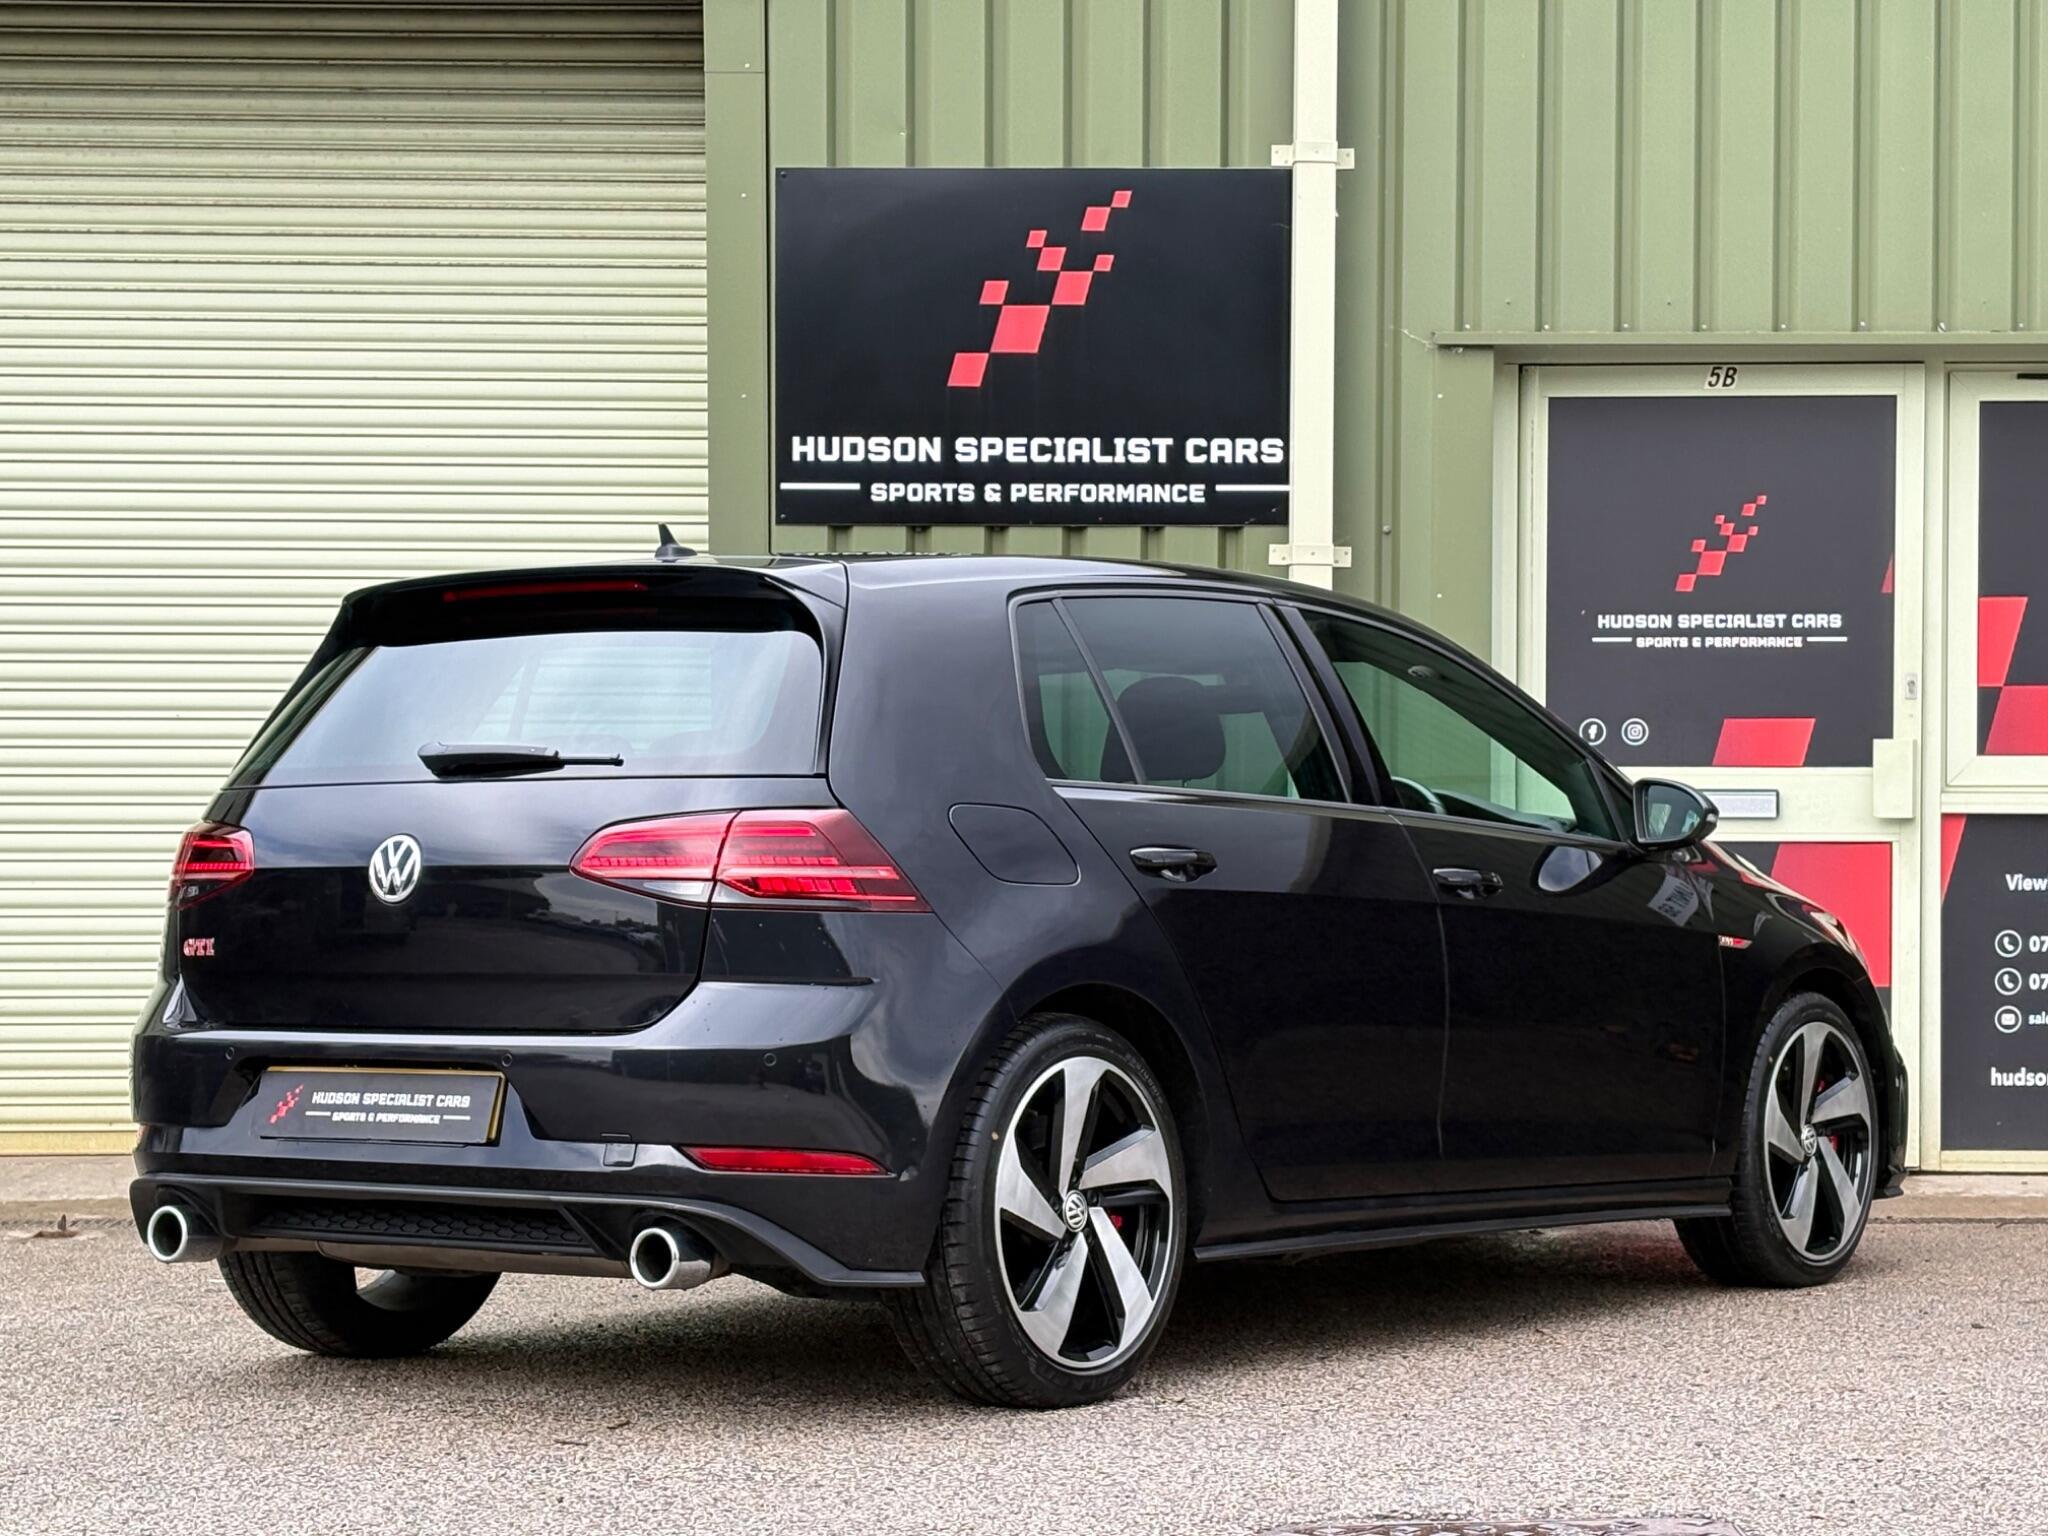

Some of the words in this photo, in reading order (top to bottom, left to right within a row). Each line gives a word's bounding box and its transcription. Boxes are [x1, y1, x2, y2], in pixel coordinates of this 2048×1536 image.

[1707, 366, 1738, 388] 5B
[791, 435, 942, 463] HUDSON
[954, 436, 1174, 464] SPECIALIST
[1185, 437, 1284, 464] CARS
[870, 482, 976, 503] SPORTS
[983, 483, 1002, 503] &
[1010, 483, 1206, 503] PERFORMANCE
[1597, 613, 1673, 629] HUDSON
[1677, 613, 1788, 629] SPECIALIST
[1791, 613, 1843, 629] CARS
[1635, 636, 1689, 649] SPORTS
[1704, 636, 1803, 648] PERFORMANCE
[183, 937, 215, 956] GTI
[1990, 1066, 2048, 1087] hudso
[311, 1091, 360, 1105] HUDSON
[362, 1092, 435, 1107] SPECIALIST
[435, 1094, 471, 1108] CARS
